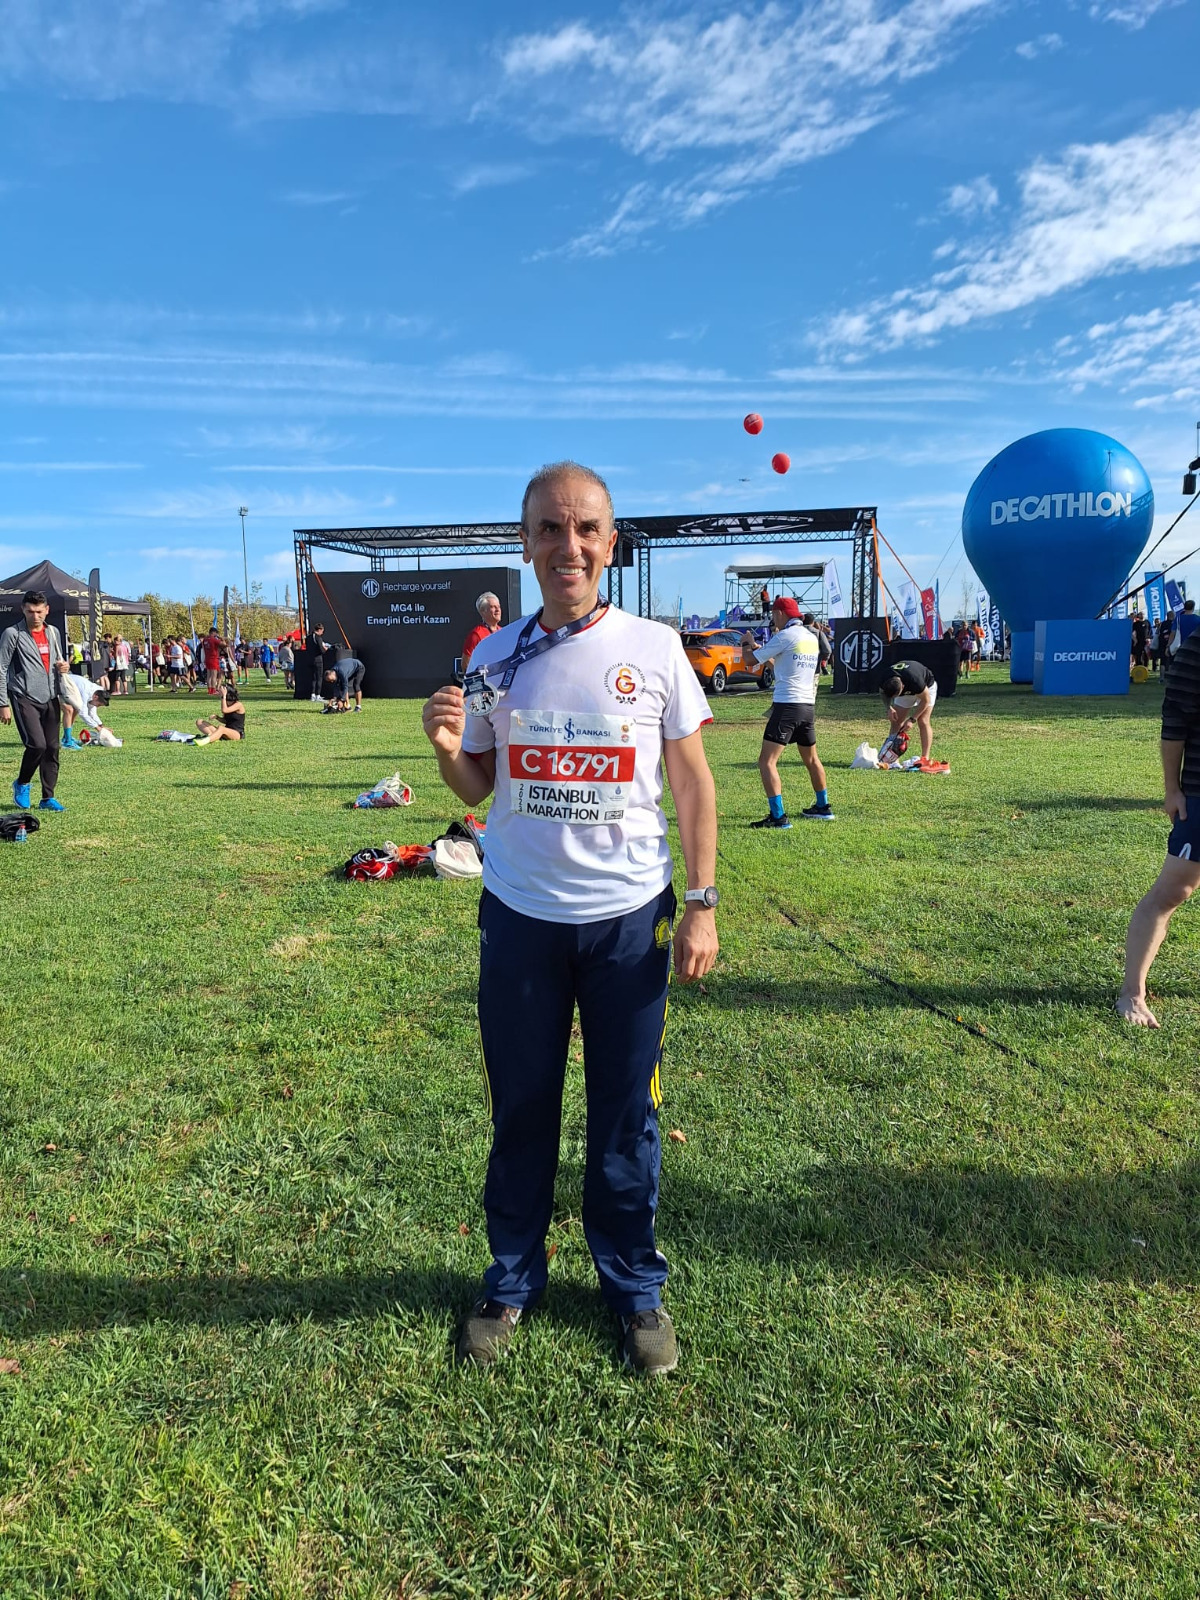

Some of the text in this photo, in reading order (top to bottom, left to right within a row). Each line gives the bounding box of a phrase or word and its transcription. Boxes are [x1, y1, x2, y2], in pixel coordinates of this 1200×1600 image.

[990, 491, 1132, 526] DECATHLON
[362, 579, 379, 597] MG
[382, 581, 452, 593] Recharge yourself
[390, 603, 425, 612] MG4 ile
[367, 615, 450, 626] Enerjini Geri Kazan
[1053, 651, 1117, 662] DECATHLON
[528, 724, 563, 734] TÜRKİYE
[576, 728, 611, 737] BANKASI
[520, 748, 620, 779] C 16791
[528, 784, 600, 805] ISTANBUL
[526, 802, 600, 821] MARATHON
